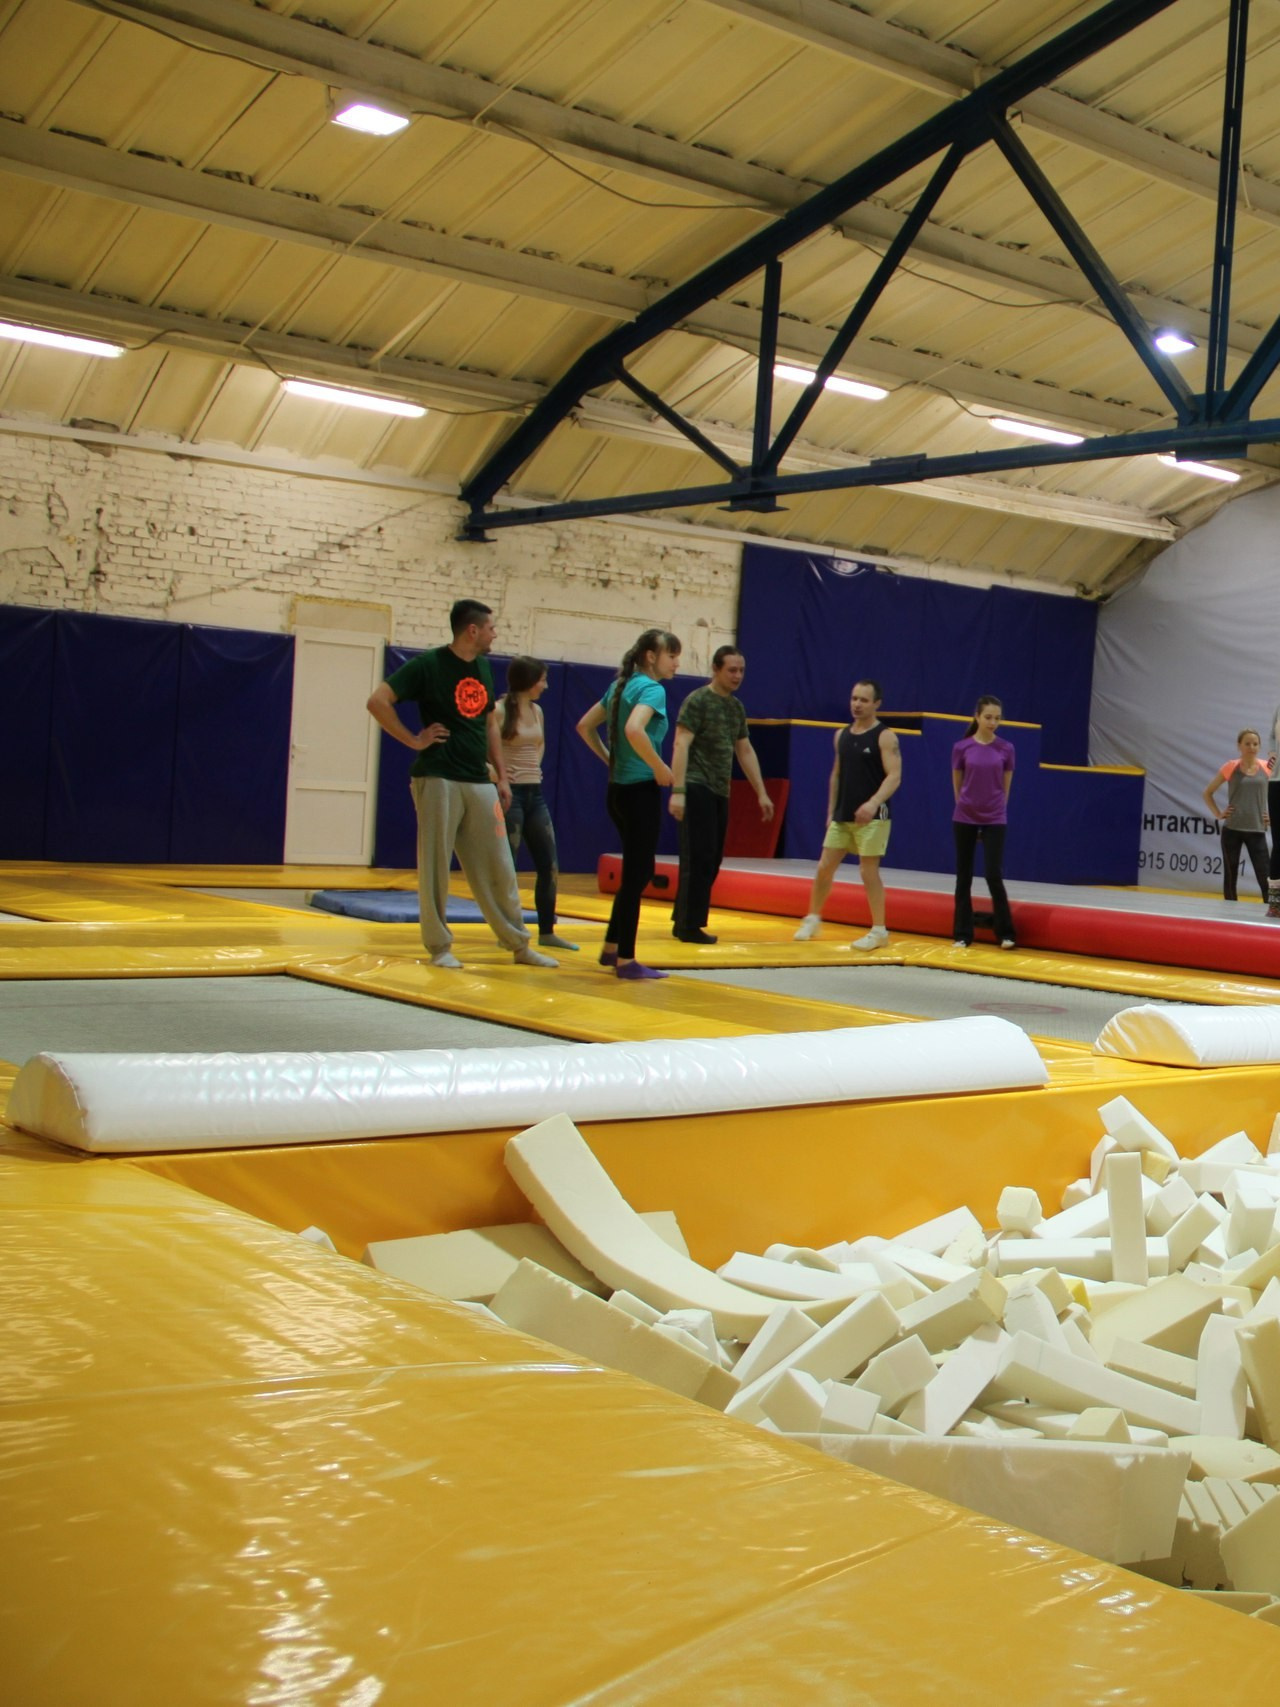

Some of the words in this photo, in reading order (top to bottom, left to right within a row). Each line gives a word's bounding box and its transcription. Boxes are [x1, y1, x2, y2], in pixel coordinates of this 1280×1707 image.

[1143, 813, 1221, 836] нтакты
[1138, 850, 1165, 870] 915
[1169, 853, 1198, 873] 090
[1203, 856, 1222, 875] 32
